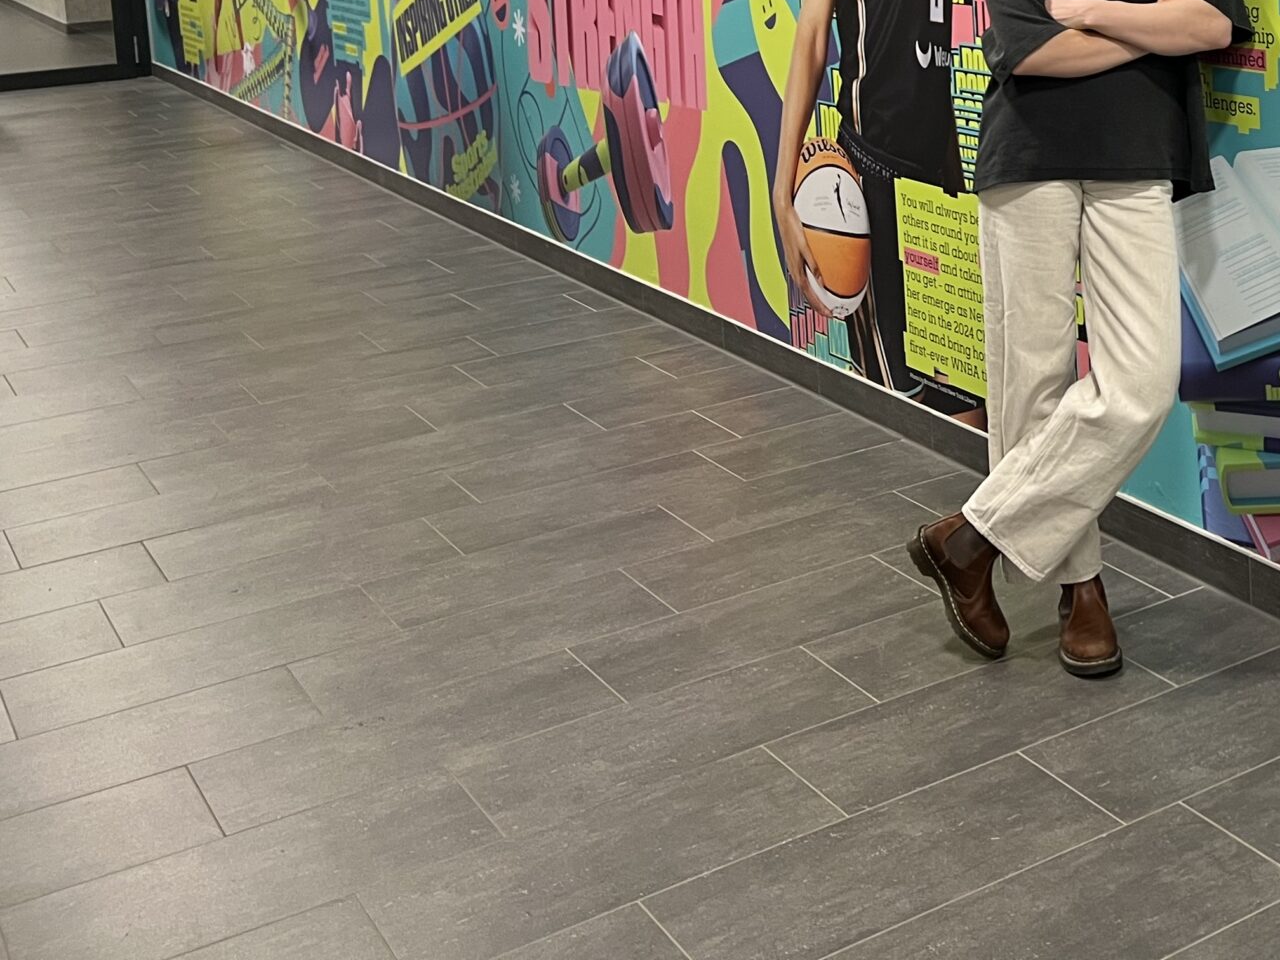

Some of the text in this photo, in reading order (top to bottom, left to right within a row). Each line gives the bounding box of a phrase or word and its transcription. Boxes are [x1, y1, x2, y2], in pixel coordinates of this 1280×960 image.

[1253, 28, 1275, 48] hip
[1204, 91, 1256, 116] llenges.
[901, 193, 917, 208] You
[918, 199, 934, 214] will
[935, 202, 968, 226] always
[902, 215, 929, 231] others
[930, 223, 962, 241] around
[903, 230, 978, 264] that it is all about
[904, 249, 982, 285] yourself and takin
[906, 270, 922, 284] you
[923, 272, 937, 290] get
[944, 282, 956, 294] an
[957, 285, 984, 304] attitu
[906, 285, 921, 300] her
[922, 292, 955, 315] emerge
[957, 304, 968, 317] as
[907, 303, 927, 320] hero
[928, 311, 936, 325] in
[937, 312, 952, 331] the
[953, 318, 975, 338] 2024
[908, 321, 985, 362] final and bring ho
[909, 339, 949, 366] first-ever
[951, 357, 980, 379] WNBA
